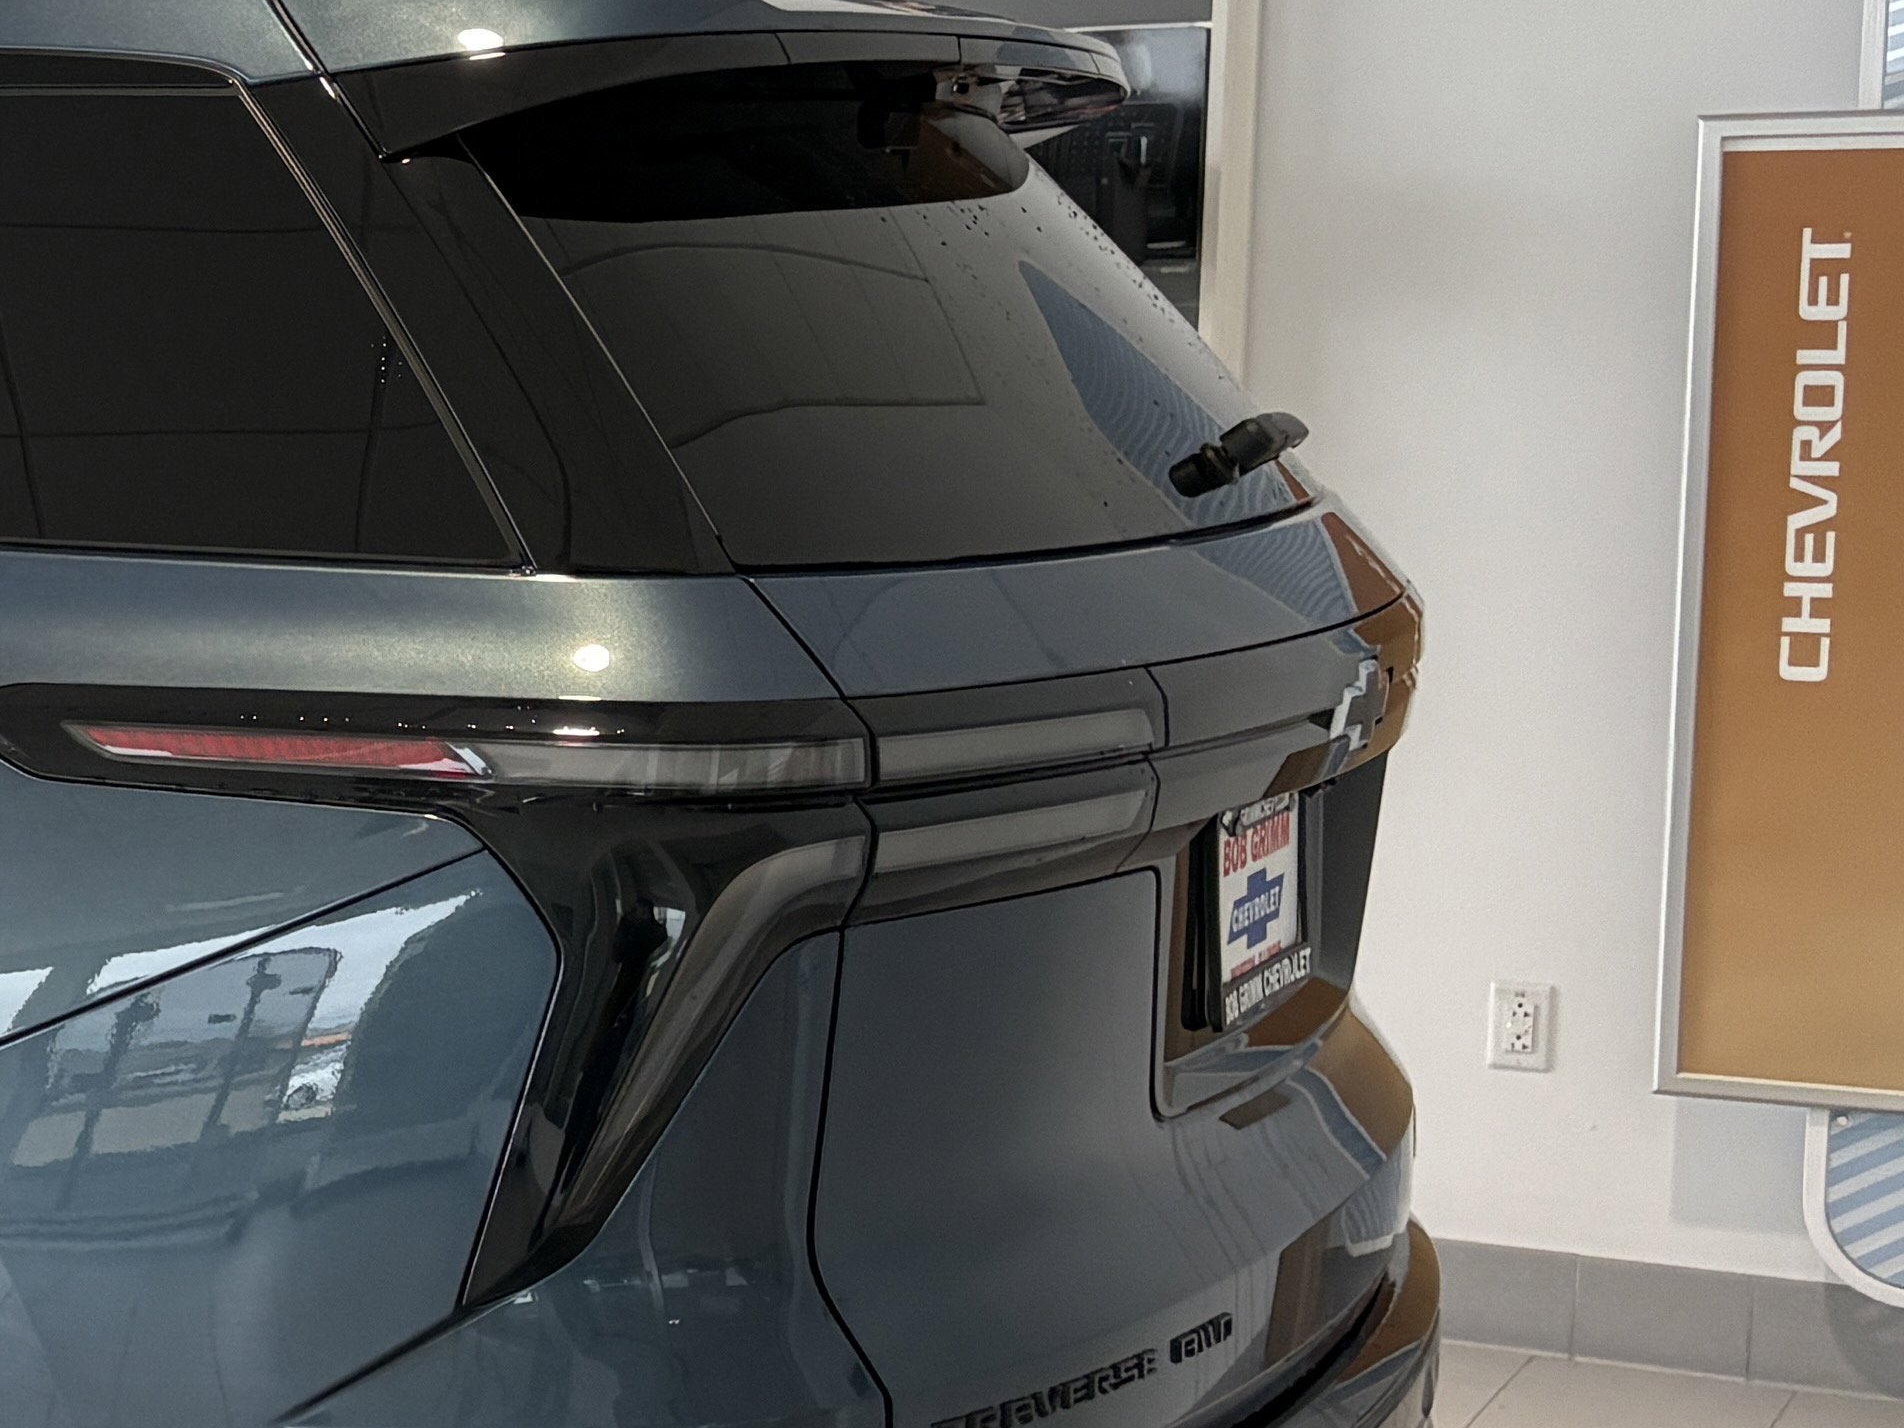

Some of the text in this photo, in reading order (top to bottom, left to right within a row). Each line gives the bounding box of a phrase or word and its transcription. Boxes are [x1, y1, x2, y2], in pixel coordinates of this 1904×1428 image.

[1778, 227, 1853, 683] CHEVROLET
[1223, 835, 1247, 878] BOB
[1251, 811, 1291, 862] GRIMM
[1231, 886, 1281, 933] CHEVROLET
[1263, 946, 1312, 998] CHEVROLET
